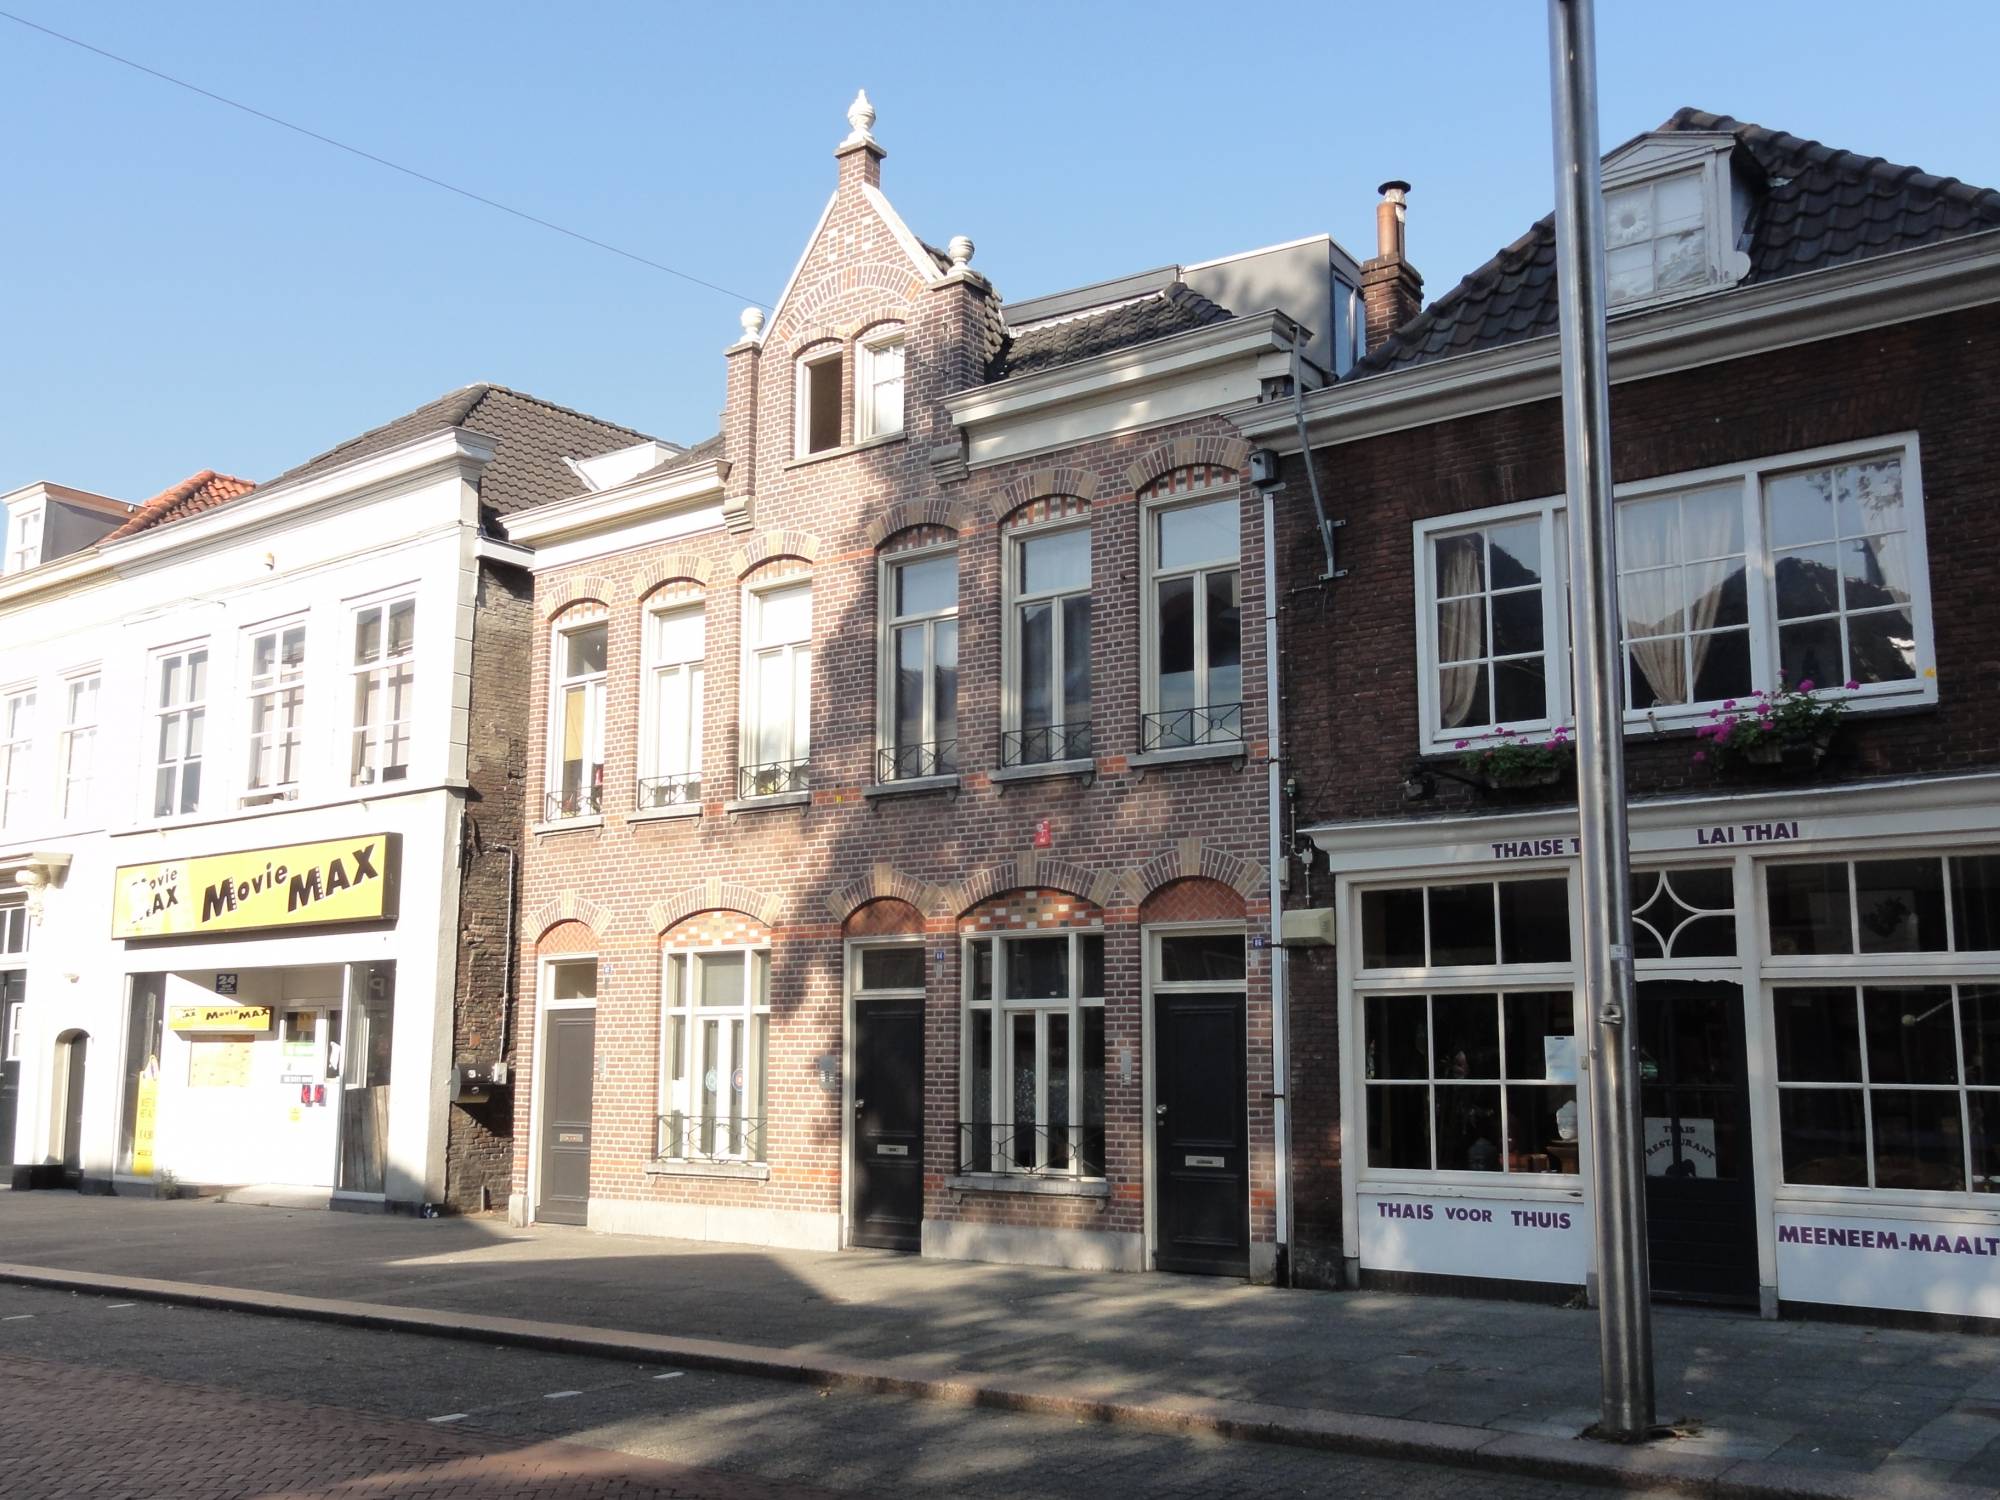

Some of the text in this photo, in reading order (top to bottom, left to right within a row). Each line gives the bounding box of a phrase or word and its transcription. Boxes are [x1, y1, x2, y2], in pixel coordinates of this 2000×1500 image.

[1697, 822, 1799, 845] LAI THAI
[1492, 840, 1564, 859] THAISE
[132, 868, 178, 890] ovie
[202, 843, 379, 923] Movie MAX
[239, 1007, 269, 1020] MAX
[1646, 1138, 1716, 1158] RESTURANT
[1377, 1202, 1571, 1229] THAIS VOOR THUIS
